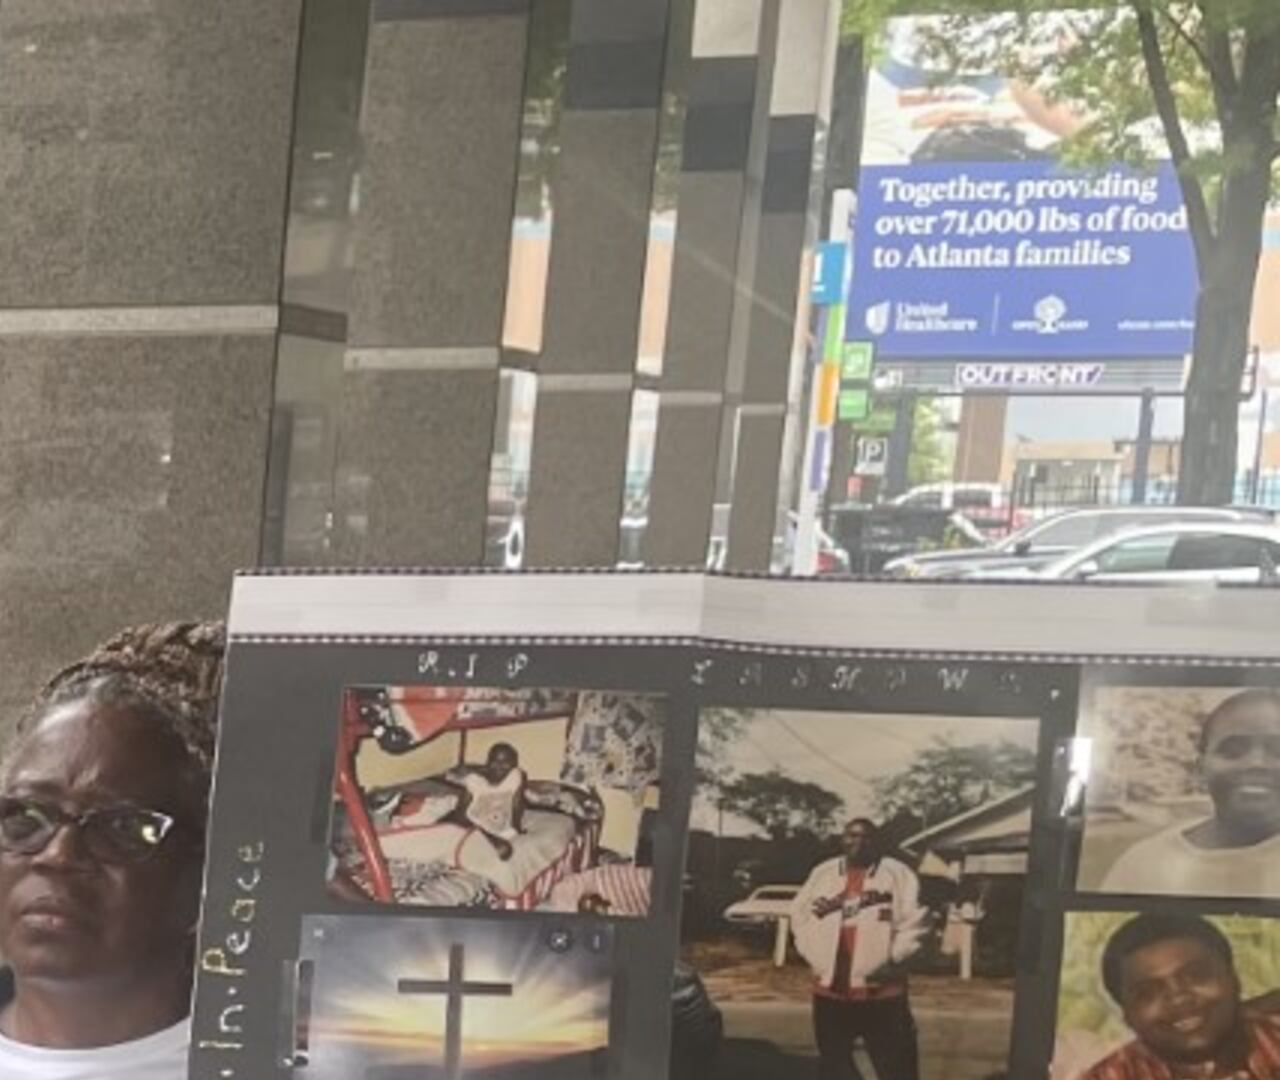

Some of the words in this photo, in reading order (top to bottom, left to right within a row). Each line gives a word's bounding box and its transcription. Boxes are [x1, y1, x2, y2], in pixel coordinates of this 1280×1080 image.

[879, 174, 1011, 207] Together,
[1016, 173, 1158, 205] providing
[875, 214, 937, 236] over
[943, 210, 1033, 237] 71,000
[1039, 207, 1081, 231] lbs
[1087, 206, 1117, 231] of
[1120, 205, 1188, 231] food
[873, 245, 901, 268] to
[905, 242, 1010, 268] Atlanta
[1014, 240, 1131, 267] families
